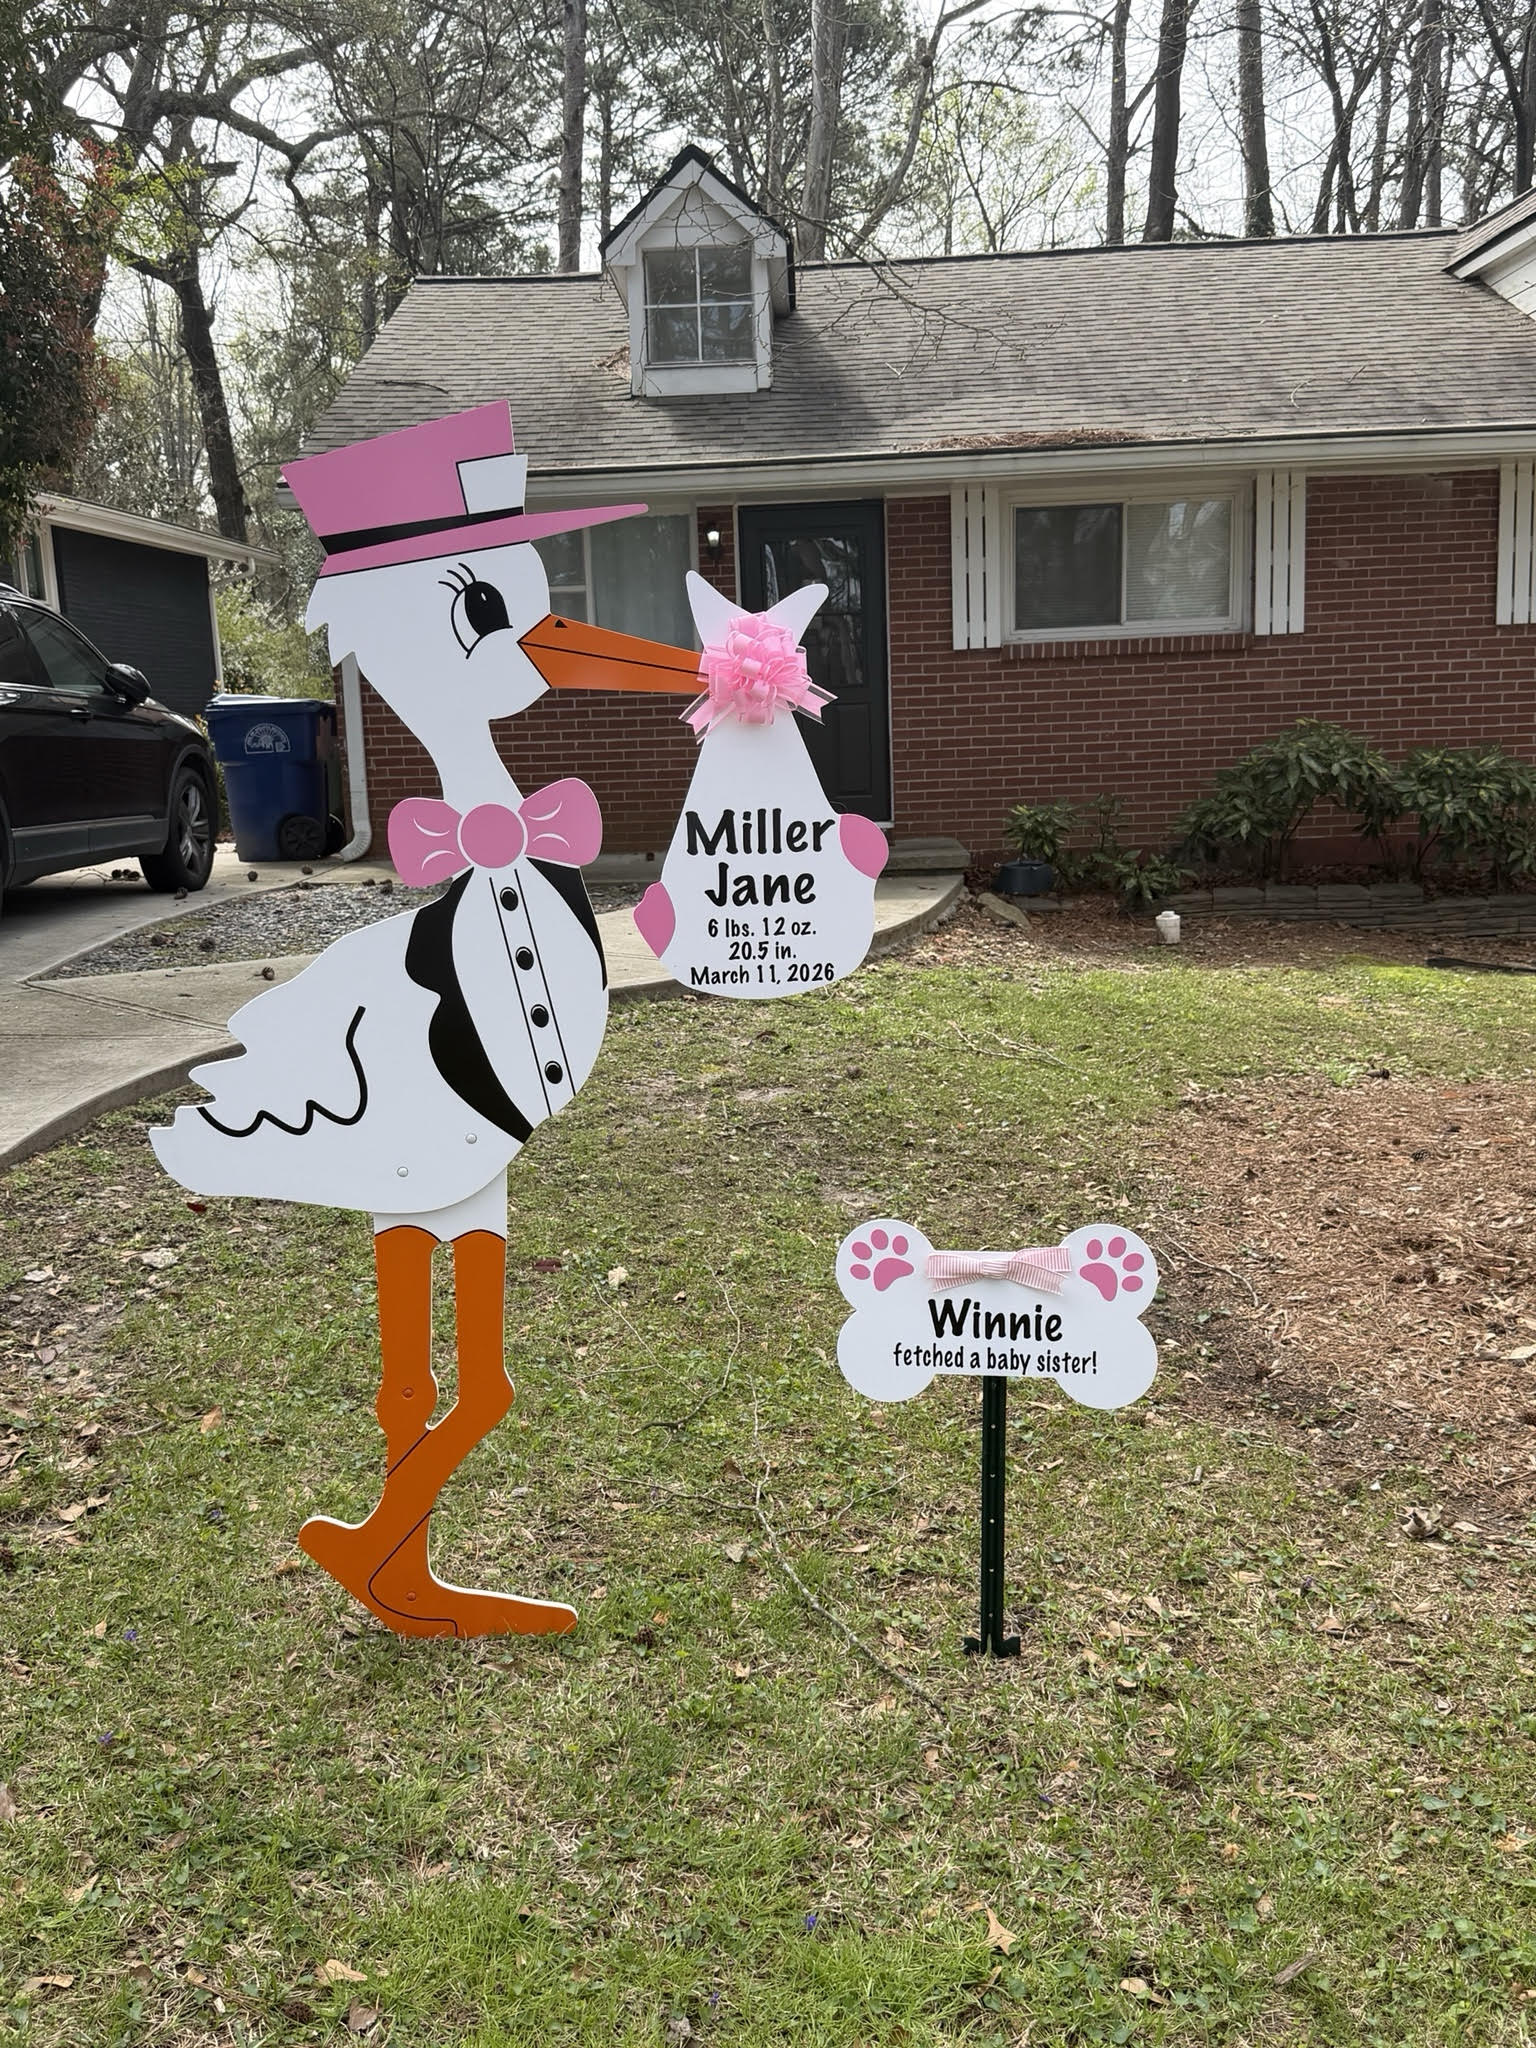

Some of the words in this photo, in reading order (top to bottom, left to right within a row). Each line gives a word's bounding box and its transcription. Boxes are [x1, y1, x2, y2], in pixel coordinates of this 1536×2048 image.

[685, 808, 836, 856] Miller
[705, 862, 816, 907] Jane
[708, 919, 718, 937] 6
[726, 918, 754, 937] lbs.
[763, 917, 785, 936] 12
[792, 922, 816, 935] oz.
[729, 941, 769, 960] 20.5
[776, 942, 796, 959] in.
[691, 965, 749, 985] March
[757, 964, 780, 984] 11,
[787, 963, 835, 983] 2026
[928, 1298, 1062, 1341] Winnie
[893, 1343, 963, 1368] fetched
[970, 1352, 980, 1368] a
[987, 1347, 1031, 1375] baby
[1037, 1350, 1096, 1374] sister!
